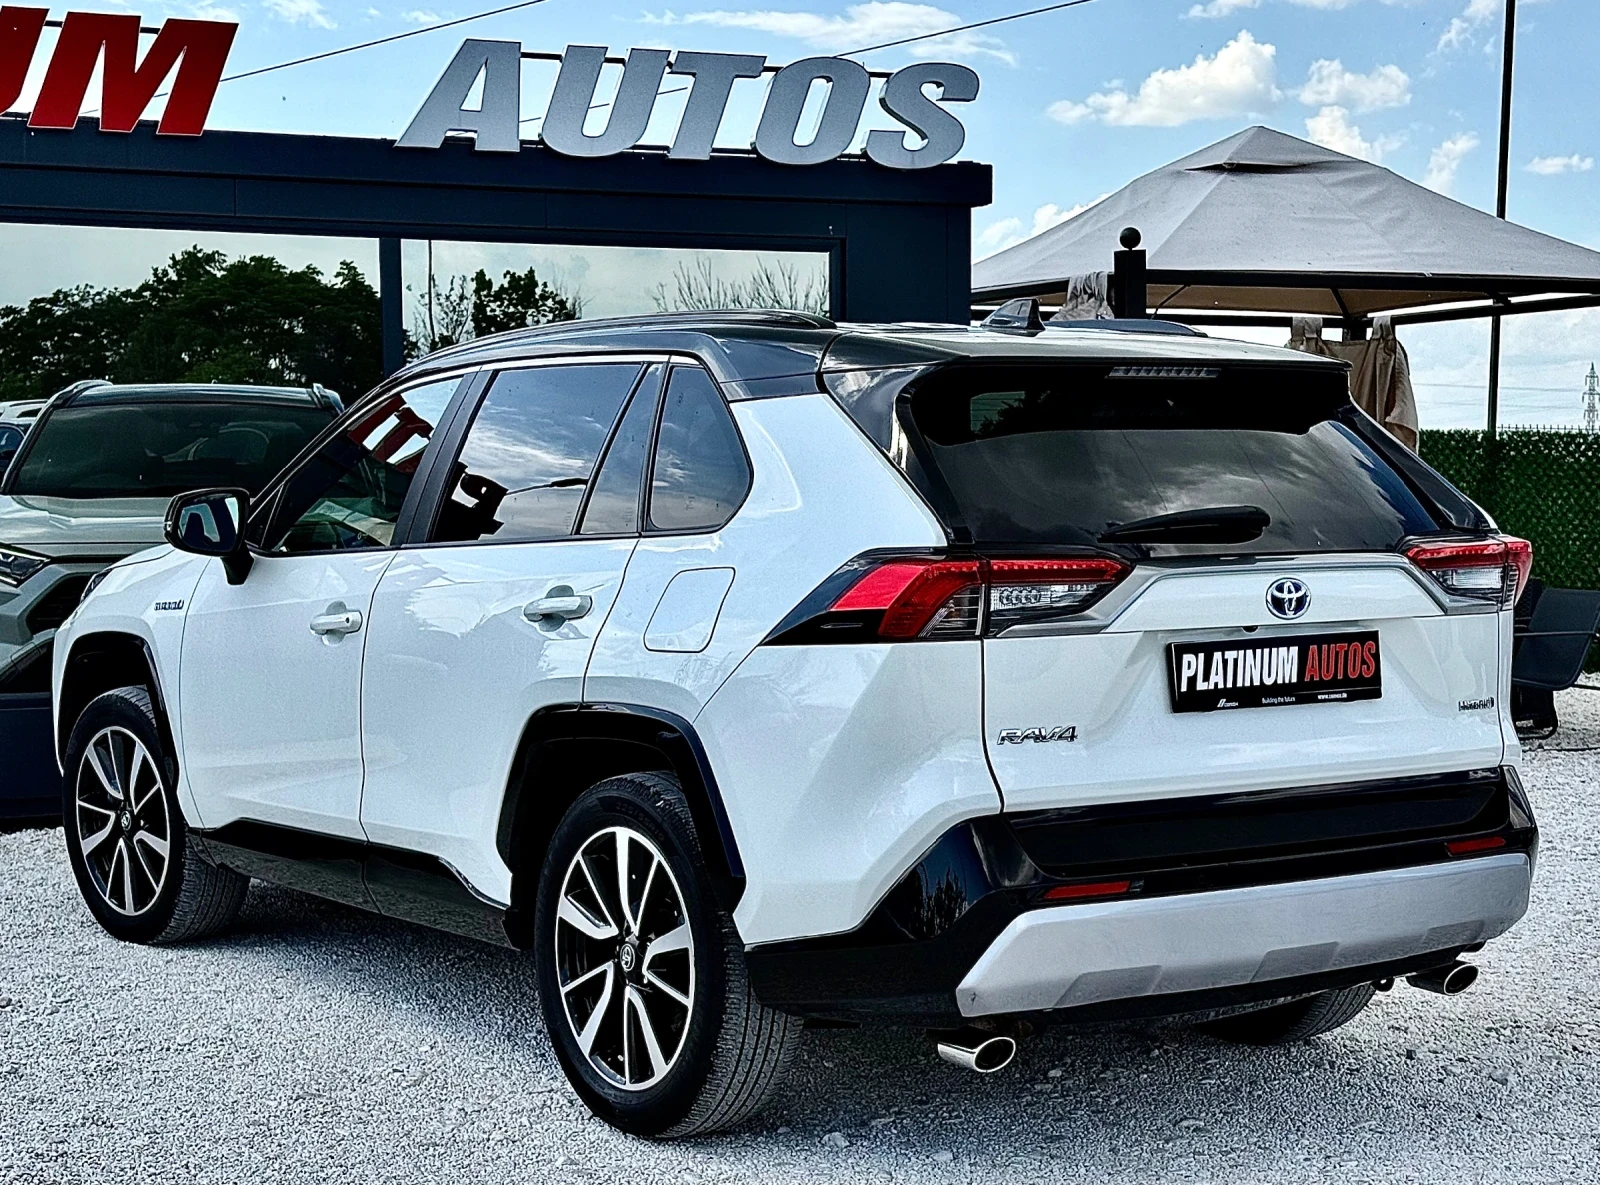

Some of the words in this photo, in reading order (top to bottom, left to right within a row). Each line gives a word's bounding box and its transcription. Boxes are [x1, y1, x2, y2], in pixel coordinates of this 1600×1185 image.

[392, 38, 981, 169] AUTOS
[1180, 646, 1299, 692] PLATINUM
[1304, 640, 1376, 682] AUTOS
[997, 724, 1078, 745] RAV4
